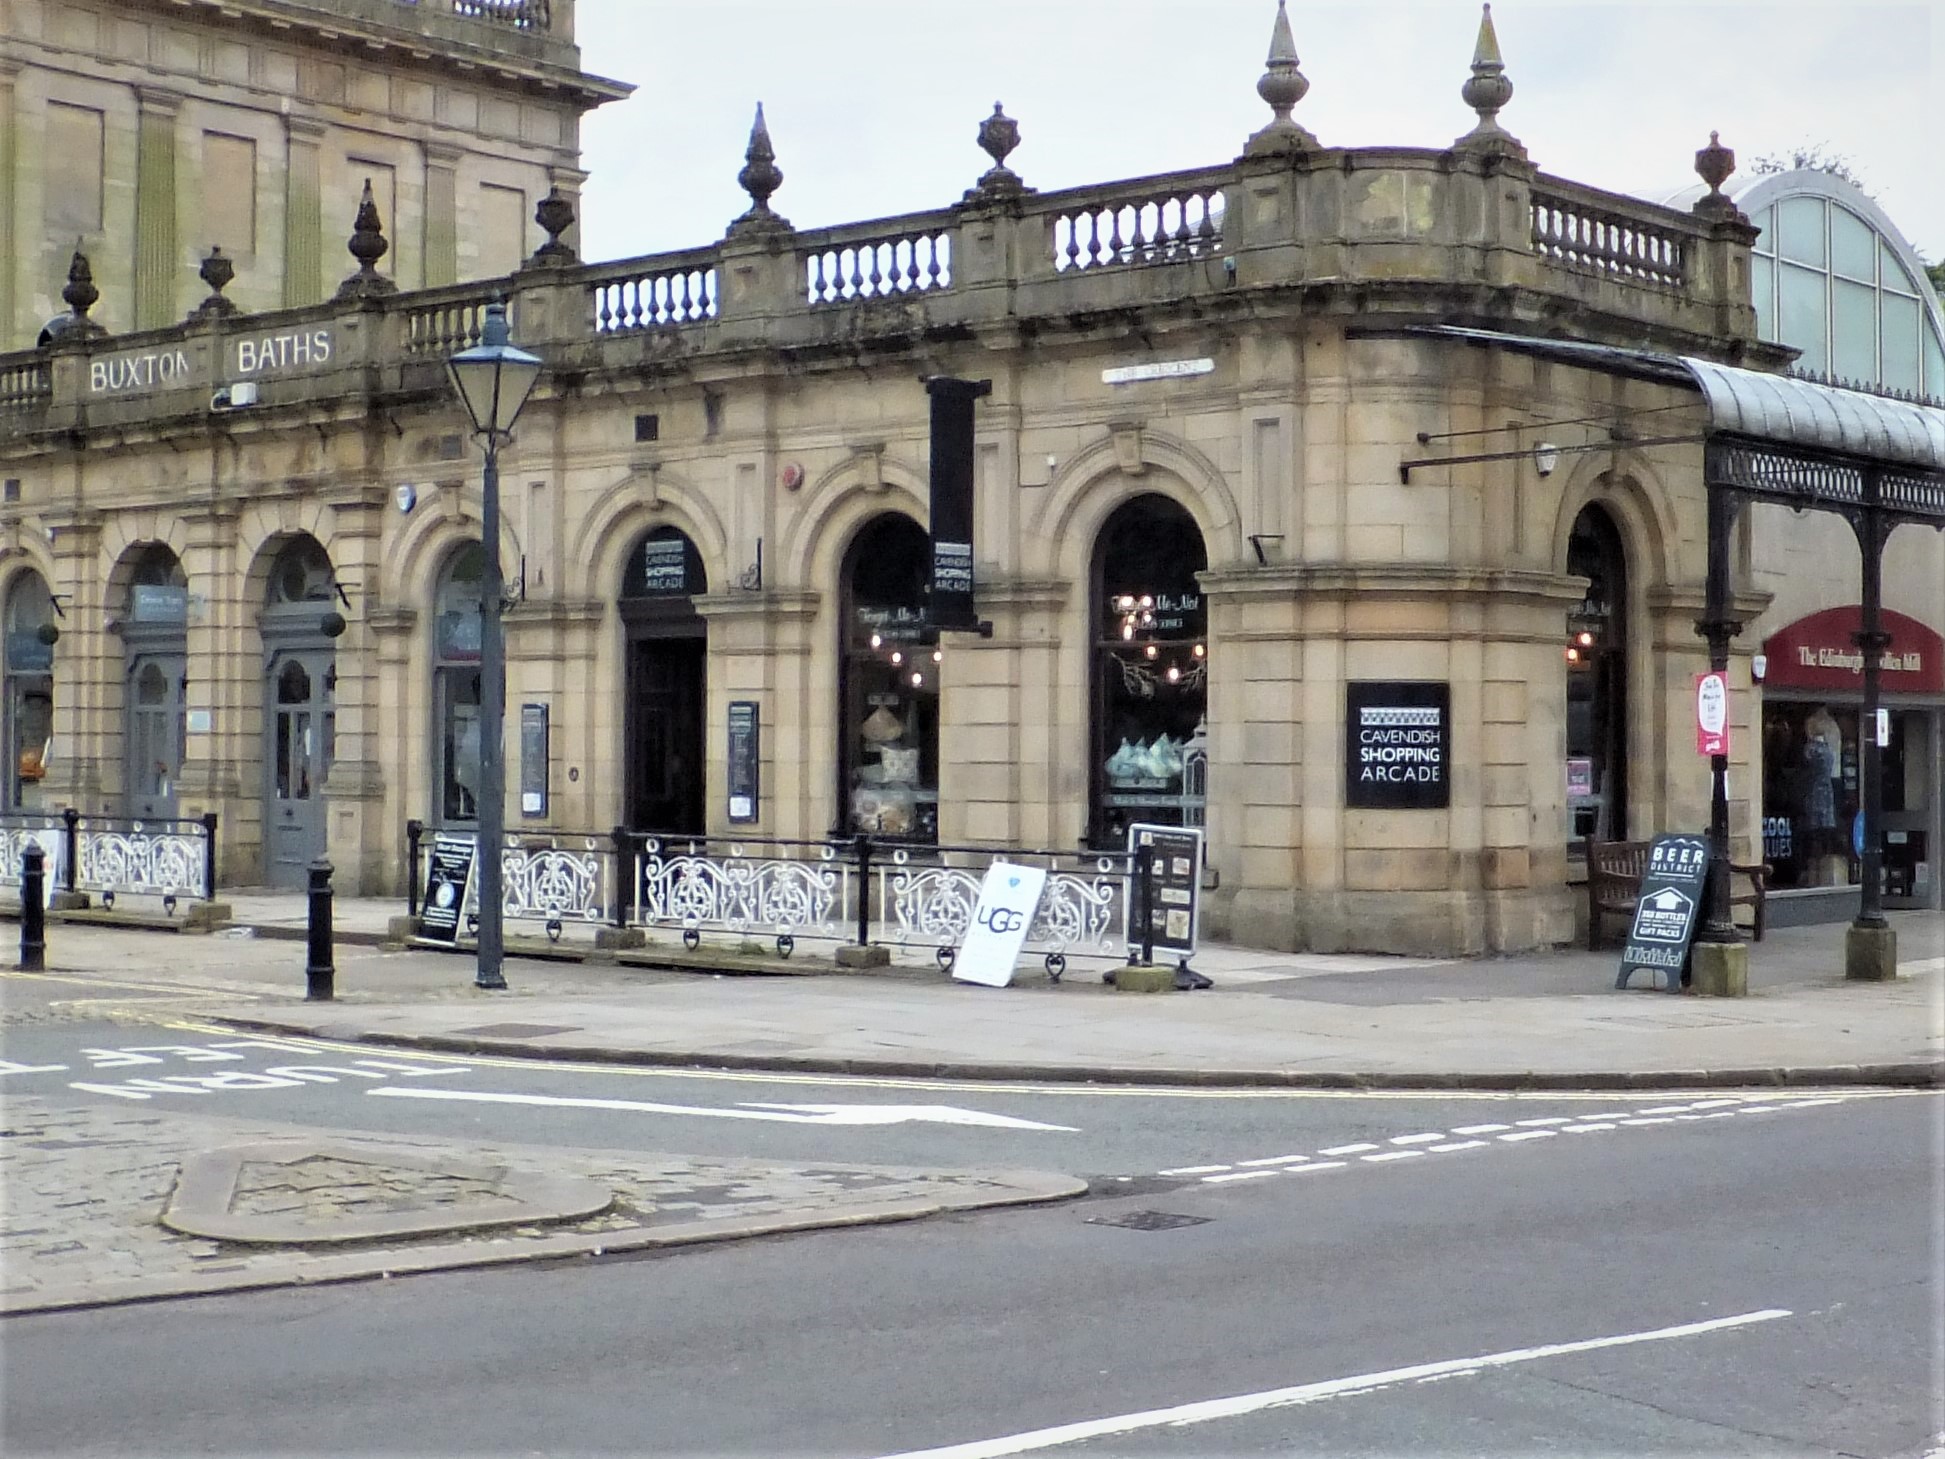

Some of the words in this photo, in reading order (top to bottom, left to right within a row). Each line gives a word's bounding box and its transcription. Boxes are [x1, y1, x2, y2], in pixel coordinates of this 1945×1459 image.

[90, 350, 189, 392] BUXTON
[238, 331, 330, 373] BATHS
[646, 577, 684, 589] ARCADE
[935, 579, 970, 591] ARCADE
[1799, 646, 1817, 666] The
[1903, 652, 1921, 671] Mill
[1360, 730, 1440, 744] CAVENDISH
[1361, 747, 1440, 762] SHOPPING
[1361, 766, 1440, 782] ARCADE
[1653, 846, 1704, 864] BEER
[1650, 861, 1702, 874] DISTRICT
[978, 905, 1024, 934] UGG
[68, 1061, 473, 1099] TURN
